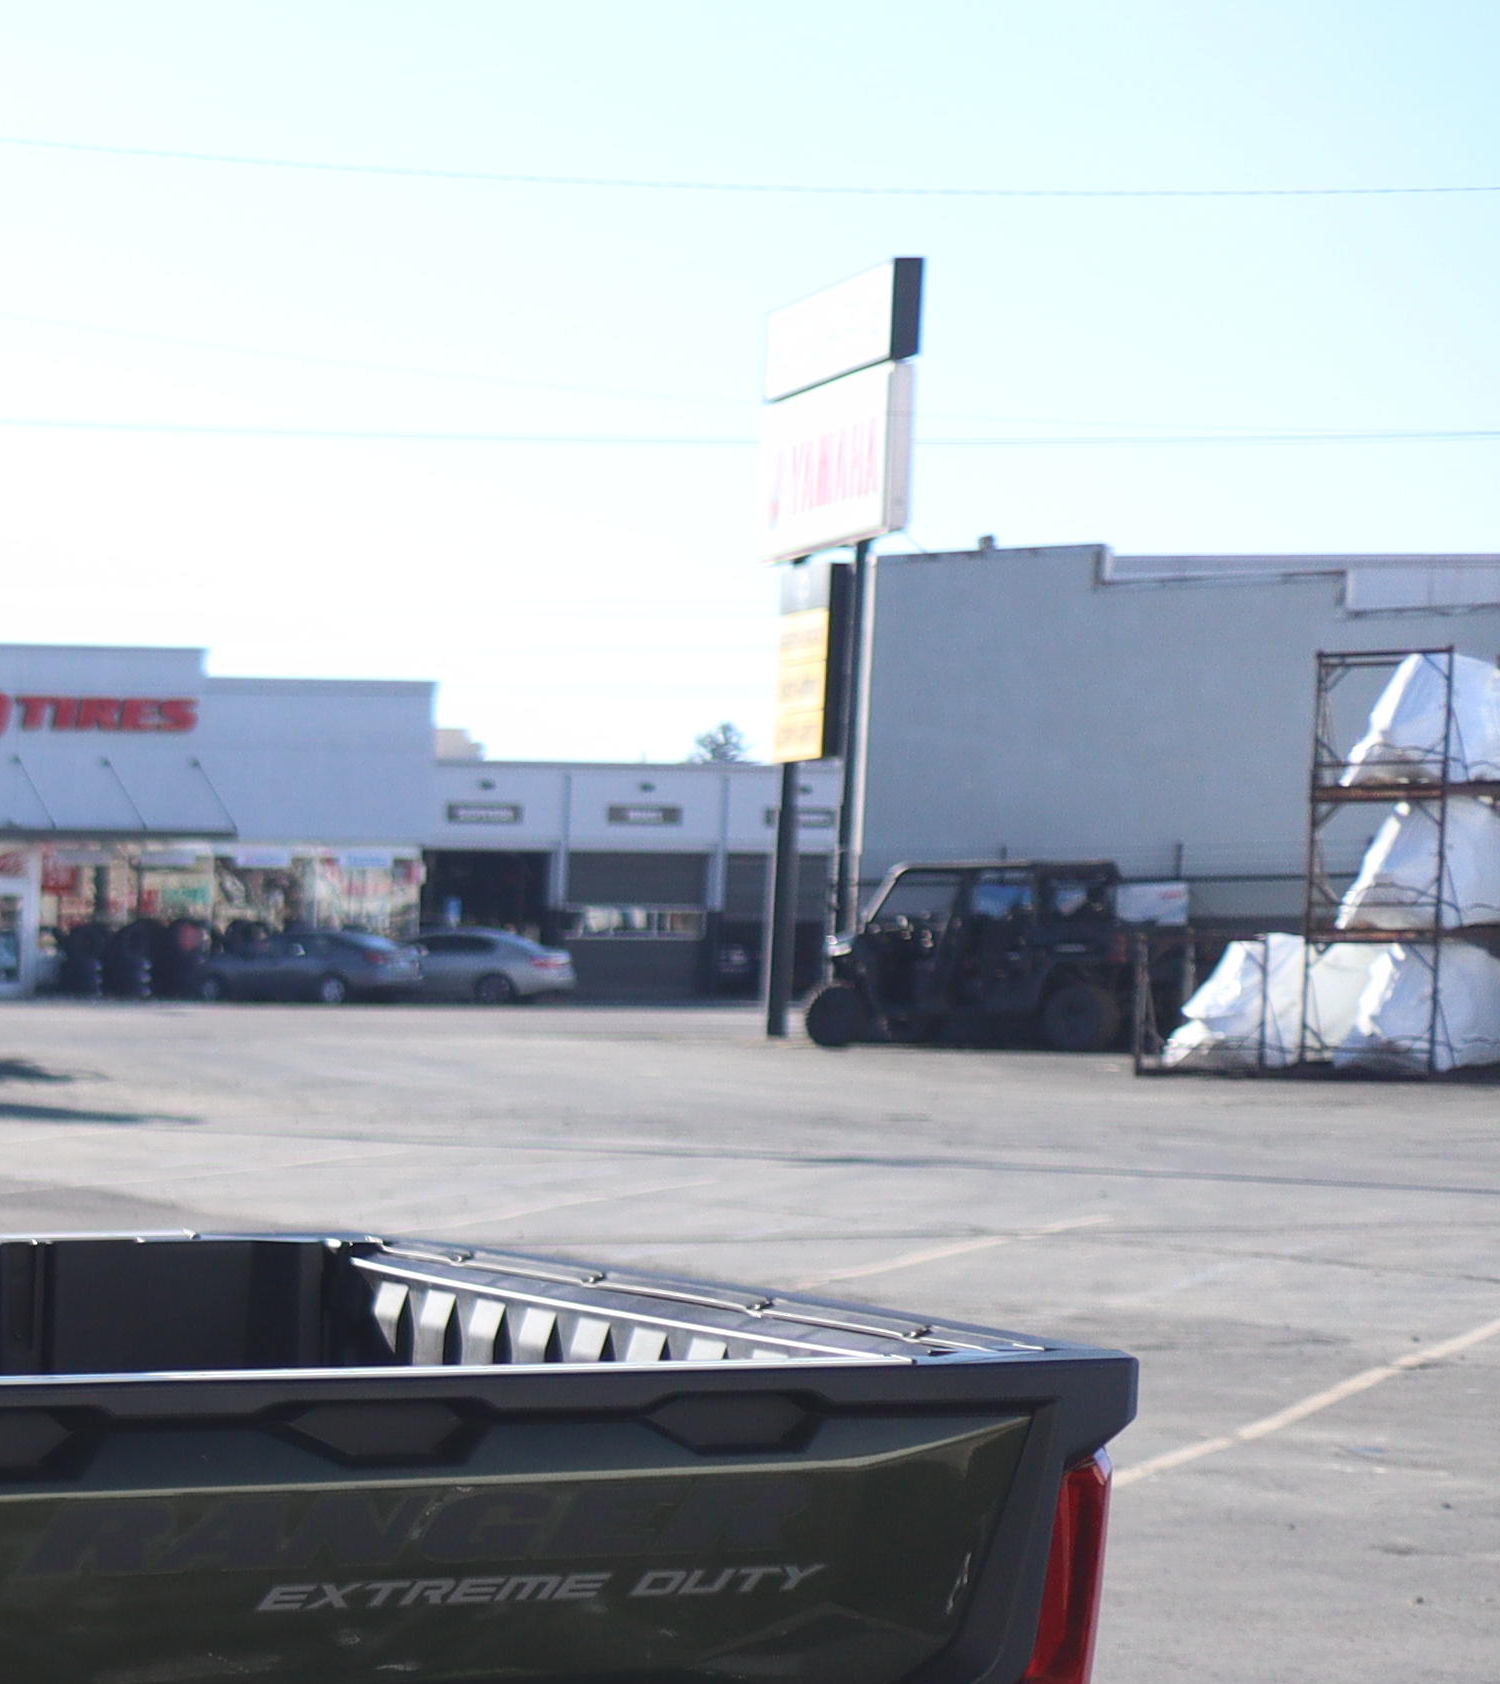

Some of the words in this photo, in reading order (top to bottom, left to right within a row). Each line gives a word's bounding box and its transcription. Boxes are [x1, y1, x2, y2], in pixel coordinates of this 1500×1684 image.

[792, 416, 878, 515] YAMAHA
[14, 695, 200, 732] TIRES
[21, 1478, 813, 1575] RANGER
[255, 1573, 612, 1613] EXTREME
[629, 1563, 826, 1599] DUTY
